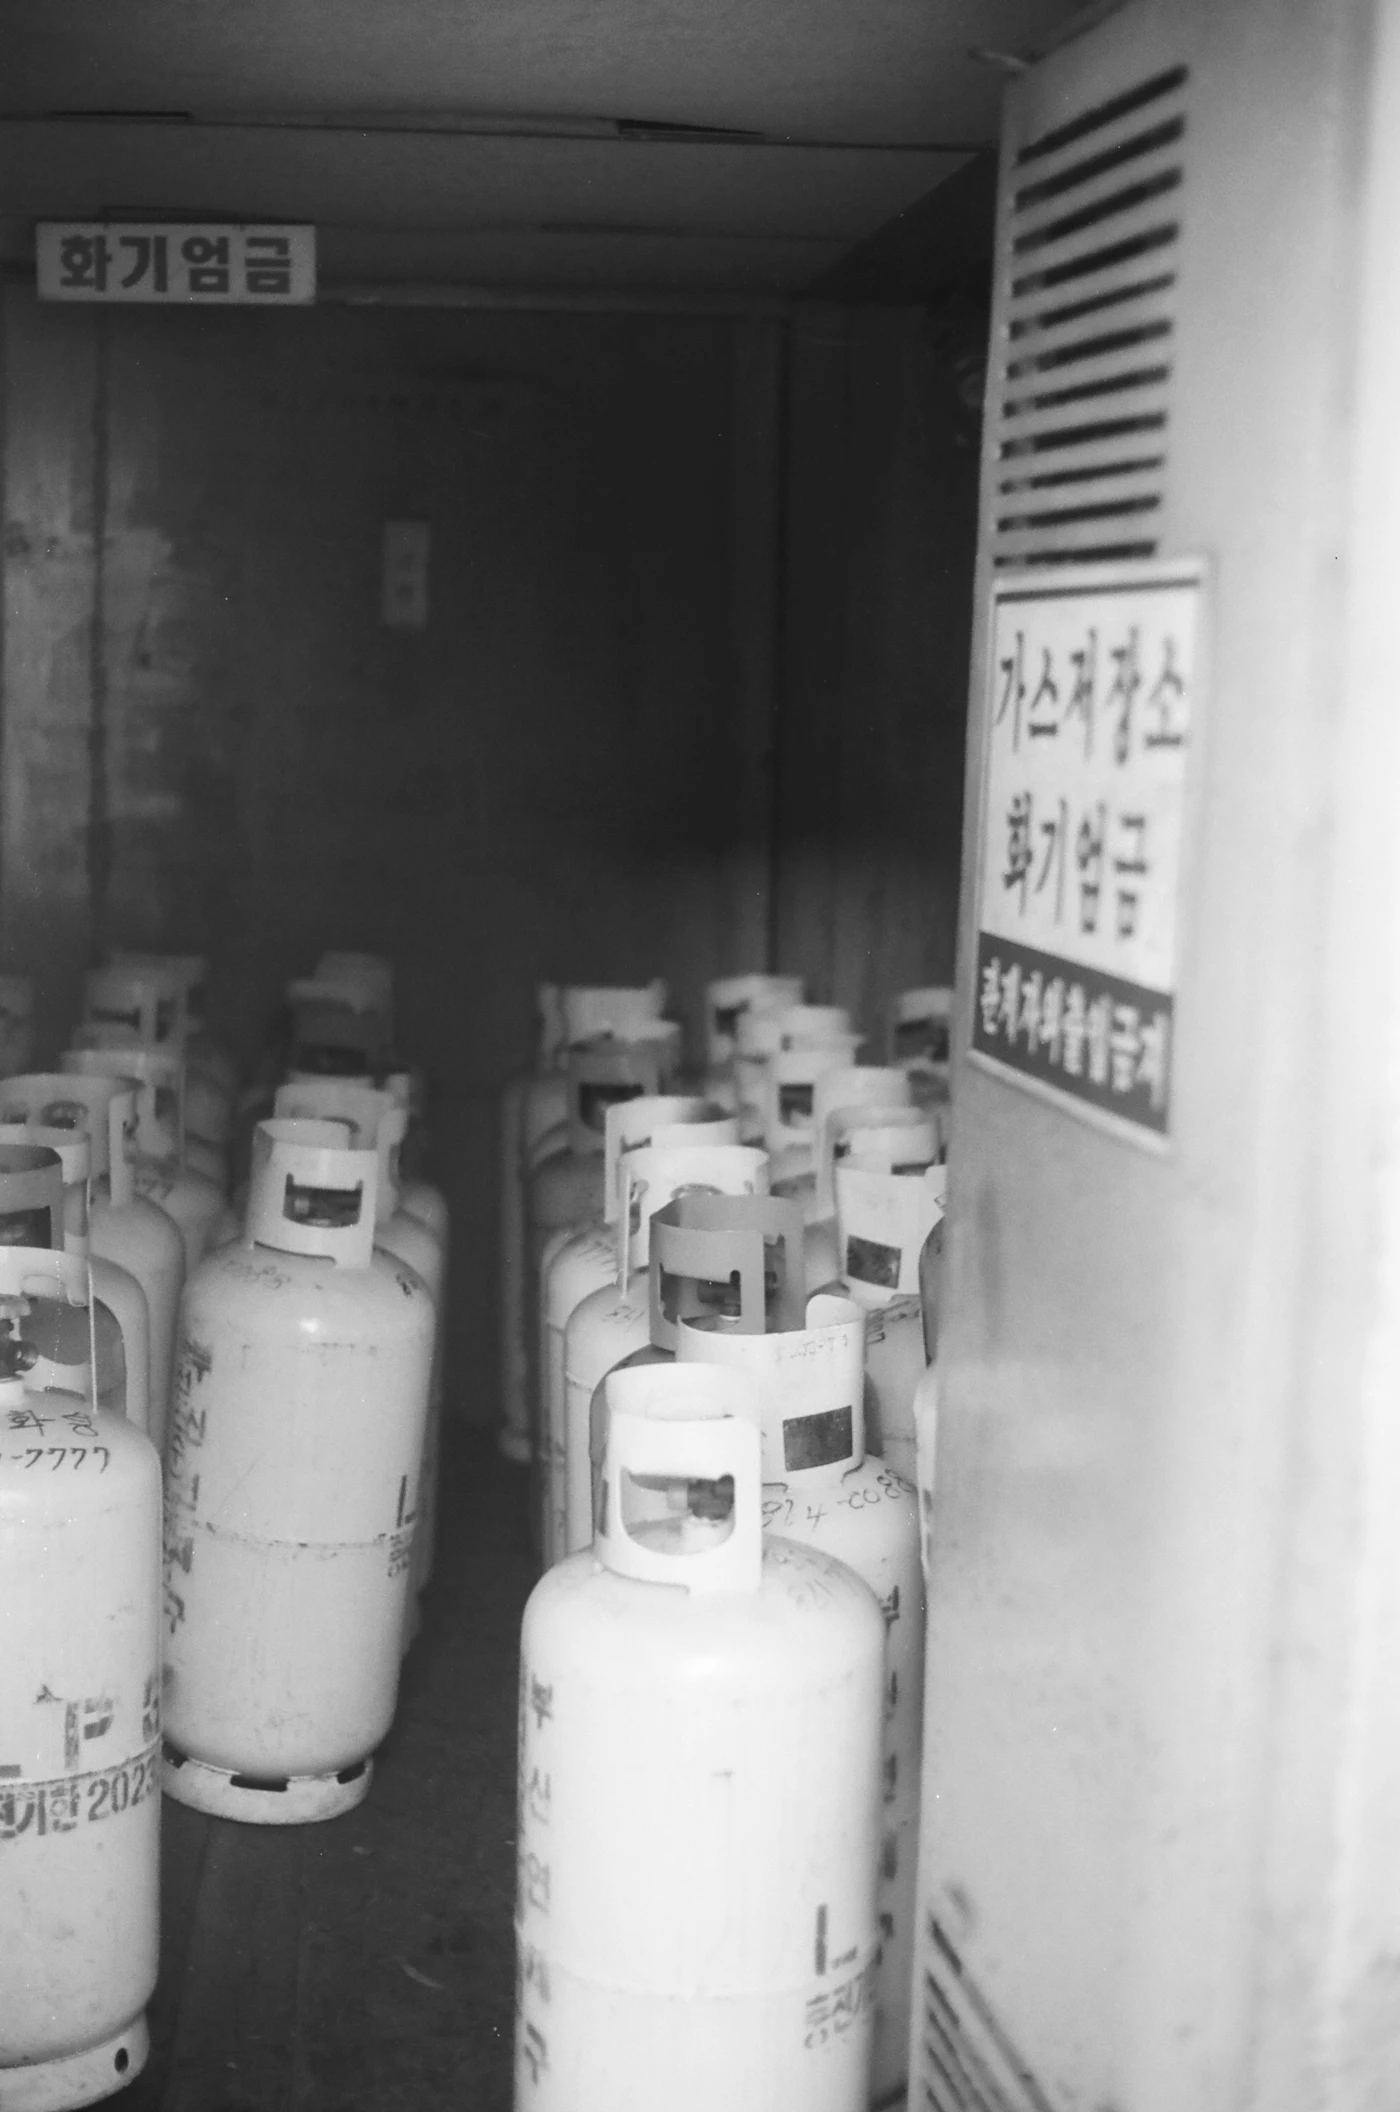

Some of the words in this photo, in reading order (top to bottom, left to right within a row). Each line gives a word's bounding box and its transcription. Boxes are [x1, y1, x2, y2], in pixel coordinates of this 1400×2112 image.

[59, 234, 293, 294] 화기엄금
[996, 622, 1184, 768] 가스저장소
[1002, 790, 1150, 938] 화기엄금
[0, 1446, 110, 1474] -7777
